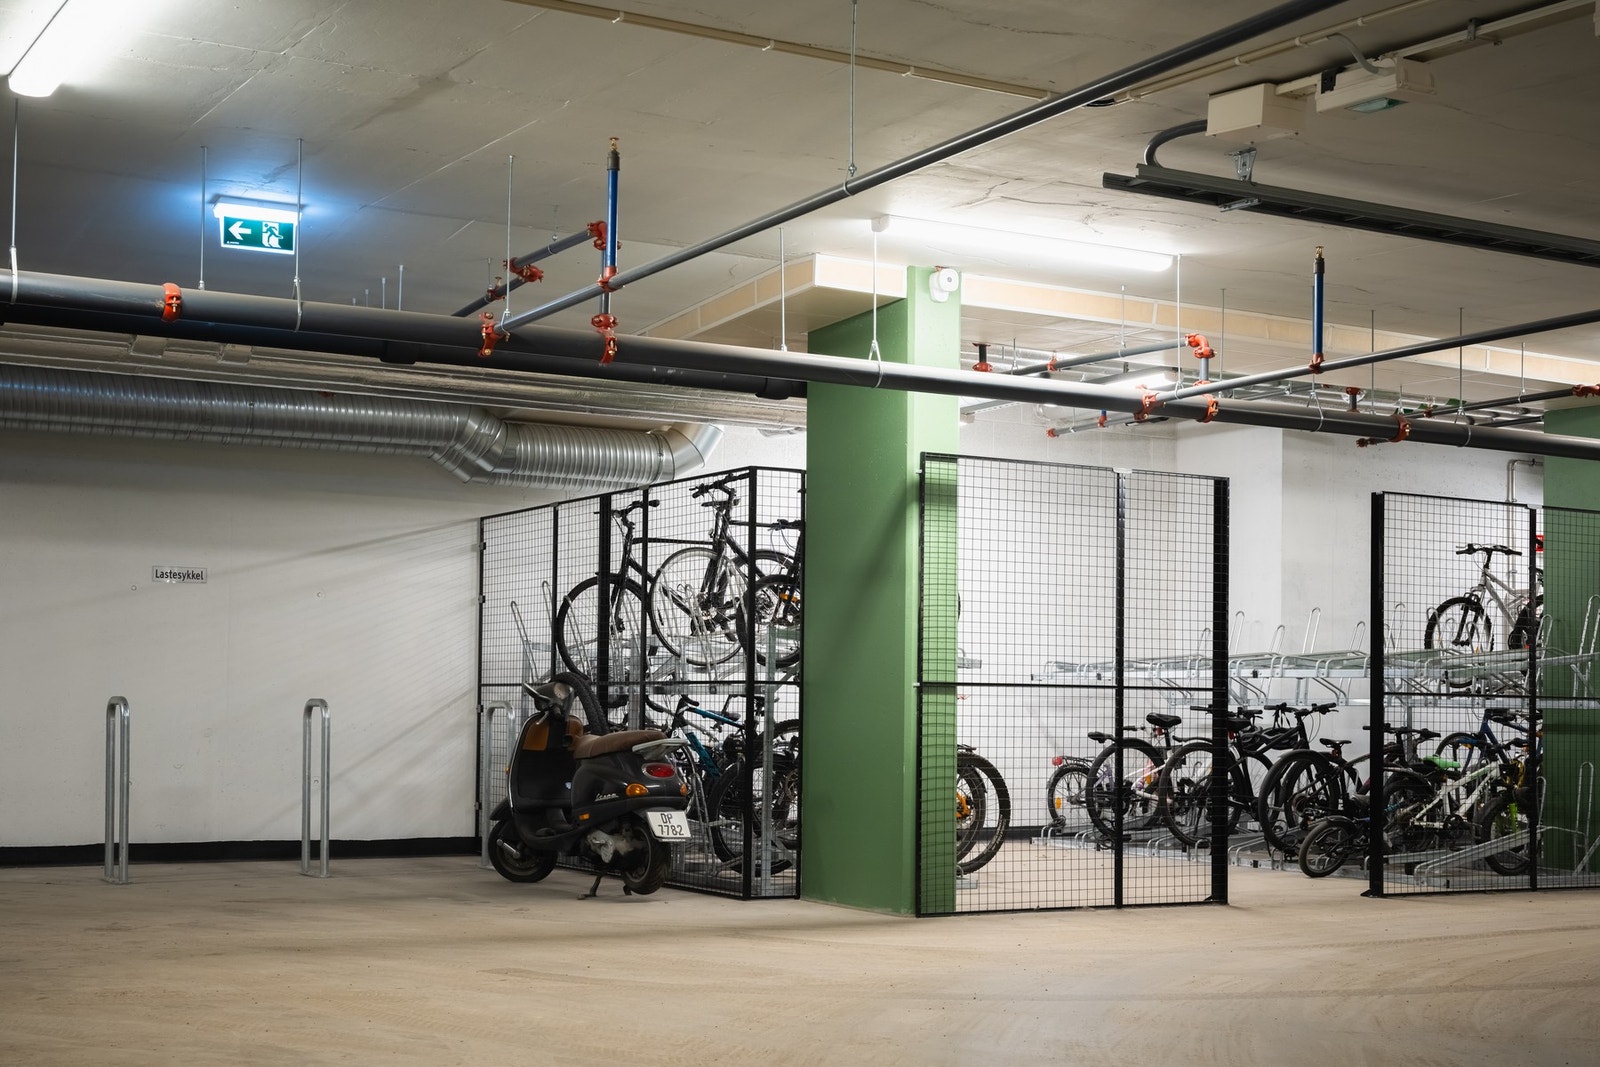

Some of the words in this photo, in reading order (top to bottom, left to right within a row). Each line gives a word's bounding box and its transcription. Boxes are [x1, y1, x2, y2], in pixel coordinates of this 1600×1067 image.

[155, 569, 204, 581] Lastesykkel
[660, 813, 673, 824] DP
[657, 824, 684, 836] 7782
